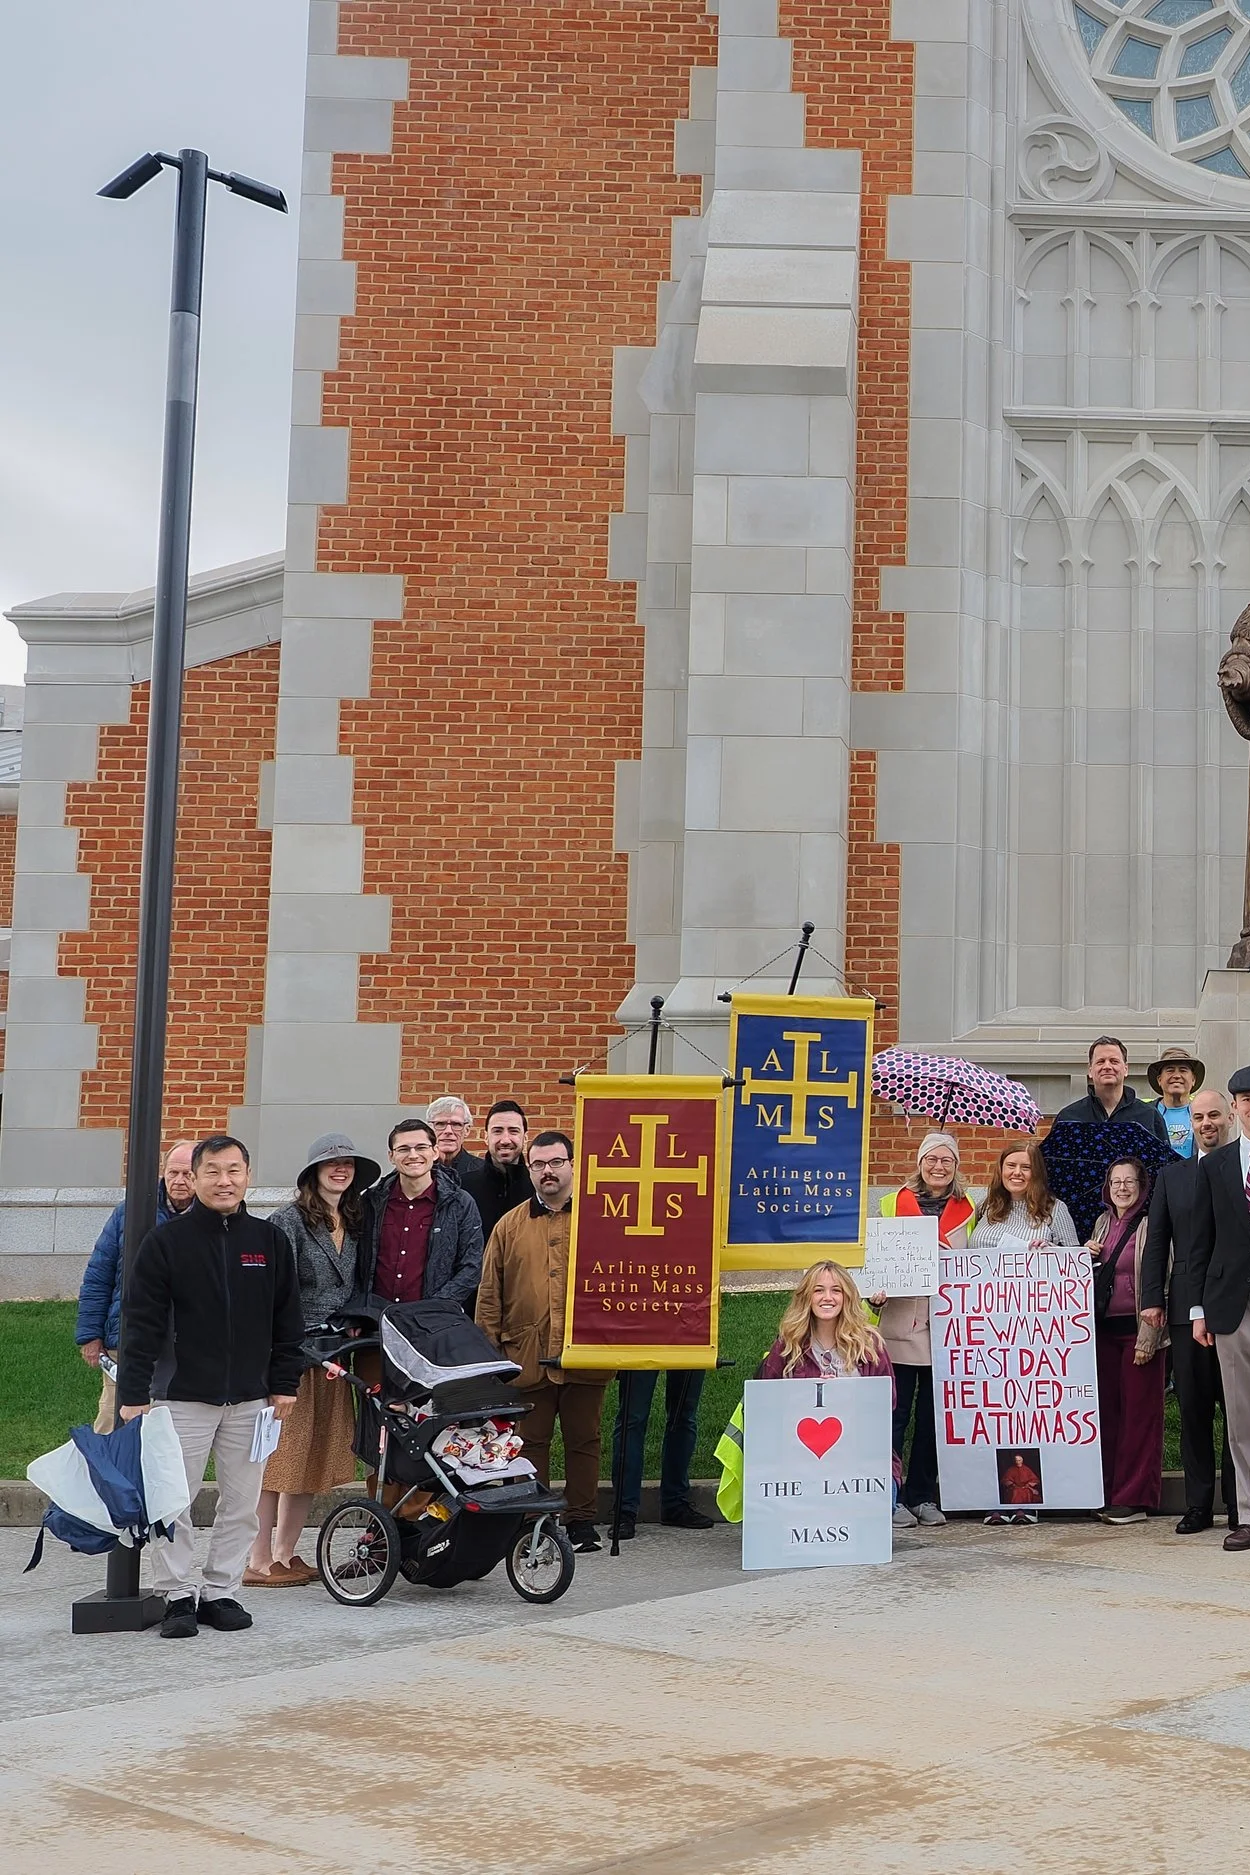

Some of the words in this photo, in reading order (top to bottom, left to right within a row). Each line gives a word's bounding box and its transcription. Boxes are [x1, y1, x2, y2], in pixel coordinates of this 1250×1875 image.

[761, 1048, 783, 1071] A
[819, 1051, 838, 1073] L
[755, 1104, 784, 1127] M
[818, 1106, 834, 1129] S
[607, 1133, 630, 1158] A
[667, 1134, 687, 1158] L
[746, 1167, 846, 1182] Arlington
[739, 1184, 791, 1196] Latin
[804, 1184, 853, 1197] Mass
[602, 1194, 630, 1218] M
[666, 1194, 683, 1219] S
[757, 1201, 833, 1216] Society
[592, 1261, 696, 1278] Arlington
[940, 1255, 982, 1278] THIS
[986, 1252, 1033, 1278] WEEK
[1037, 1252, 1054, 1278] IT
[1054, 1252, 1091, 1278] WAS
[584, 1279, 639, 1293] Latin
[653, 1280, 704, 1294] Mass
[934, 1283, 971, 1316] ST.
[972, 1281, 1021, 1314] JOHN
[1027, 1279, 1091, 1313] HENRY
[602, 1298, 683, 1314] Society
[943, 1312, 1091, 1347] NEWMAN'S
[950, 1347, 1010, 1378] FEAST
[1019, 1348, 1072, 1377] DAY
[813, 1383, 827, 1408] I
[943, 1380, 978, 1409] HE
[982, 1378, 1063, 1409] LOVED
[1064, 1384, 1094, 1398] THE
[945, 1411, 1026, 1445] LATIN
[1028, 1410, 1097, 1445] MASS
[760, 1481, 802, 1497] THE
[824, 1478, 886, 1495] LATIN
[791, 1526, 849, 1544] MASS
